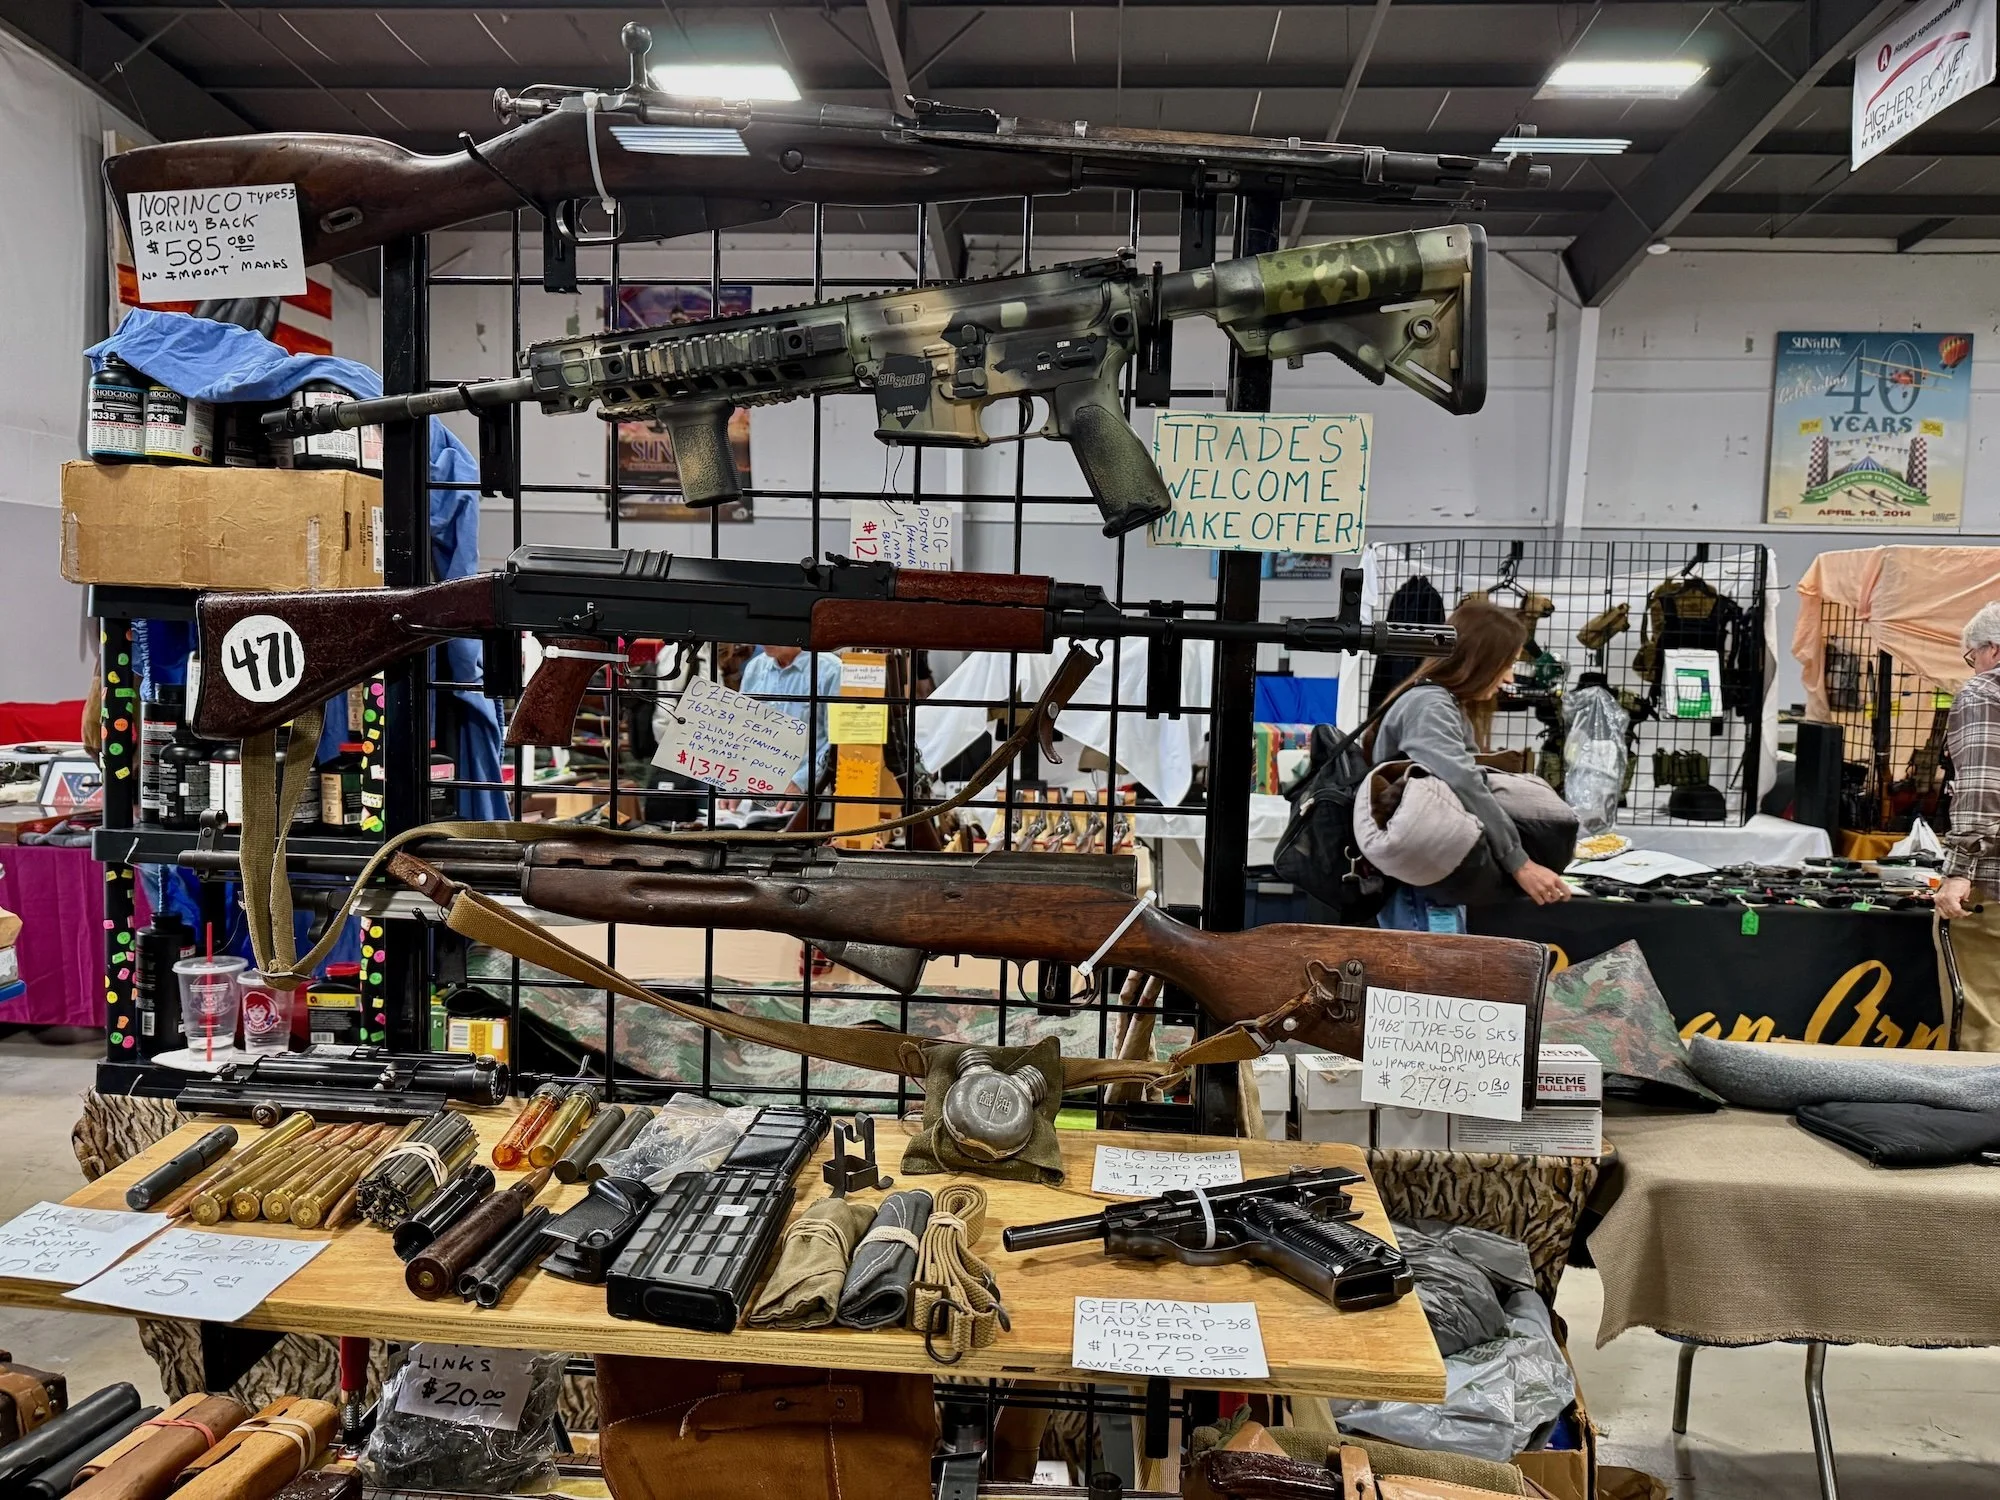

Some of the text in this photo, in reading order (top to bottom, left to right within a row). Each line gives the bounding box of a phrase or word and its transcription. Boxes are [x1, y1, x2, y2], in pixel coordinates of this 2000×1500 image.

[1917, 5, 1955, 37] sponsored
[1863, 85, 1915, 136] HIGHER
[139, 191, 242, 220] NORINCO
[205, 213, 259, 231] BACK
[1056, 341, 1071, 349] SEMI
[1036, 363, 1051, 372] SAFE
[1825, 339, 1924, 415] 40
[96, 389, 139, 400] HODGDON
[1779, 372, 1848, 404] Celebrating
[1829, 415, 1913, 433] YEARS
[631, 440, 673, 463] SUN
[1164, 423, 1343, 464] TRADES
[1158, 465, 1340, 503] WELCOME
[1817, 508, 1855, 517] APRIL
[1883, 509, 1912, 517] 2014
[917, 507, 930, 553] PISTON
[932, 516, 949, 553] SIG
[1157, 510, 1354, 543] MAKE OFFER
[230, 631, 296, 692] 471
[691, 681, 760, 715] CZECH
[764, 708, 807, 736] VZ-58
[742, 719, 780, 738] SEMI
[1373, 991, 1500, 1023] NORINCO
[1409, 1020, 1477, 1040] TYPE-56
[1366, 1034, 1440, 1055] VIETNAM
[1487, 1049, 1524, 1067] BACK
[1537, 1084, 1586, 1092] BULLETS
[1104, 1147, 1147, 1162] SIG
[1155, 1152, 1191, 1163] 516
[1193, 1154, 1221, 1162] GEN
[1104, 1160, 1144, 1170] 5.56
[1196, 1162, 1237, 1170] AR-15
[23, 1208, 120, 1225] AK-47
[24, 1226, 79, 1238] SKS
[35, 1247, 101, 1259] KITS
[230, 1239, 311, 1256] BMG
[1079, 1299, 1211, 1315] GERMAN
[1079, 1314, 1252, 1331] MAUSER P-38
[1103, 1328, 1150, 1340] 1945
[418, 1353, 492, 1372] LINKS
[1077, 1359, 1248, 1376] AWESOME COND.
[421, 1376, 506, 1407] $20.00
